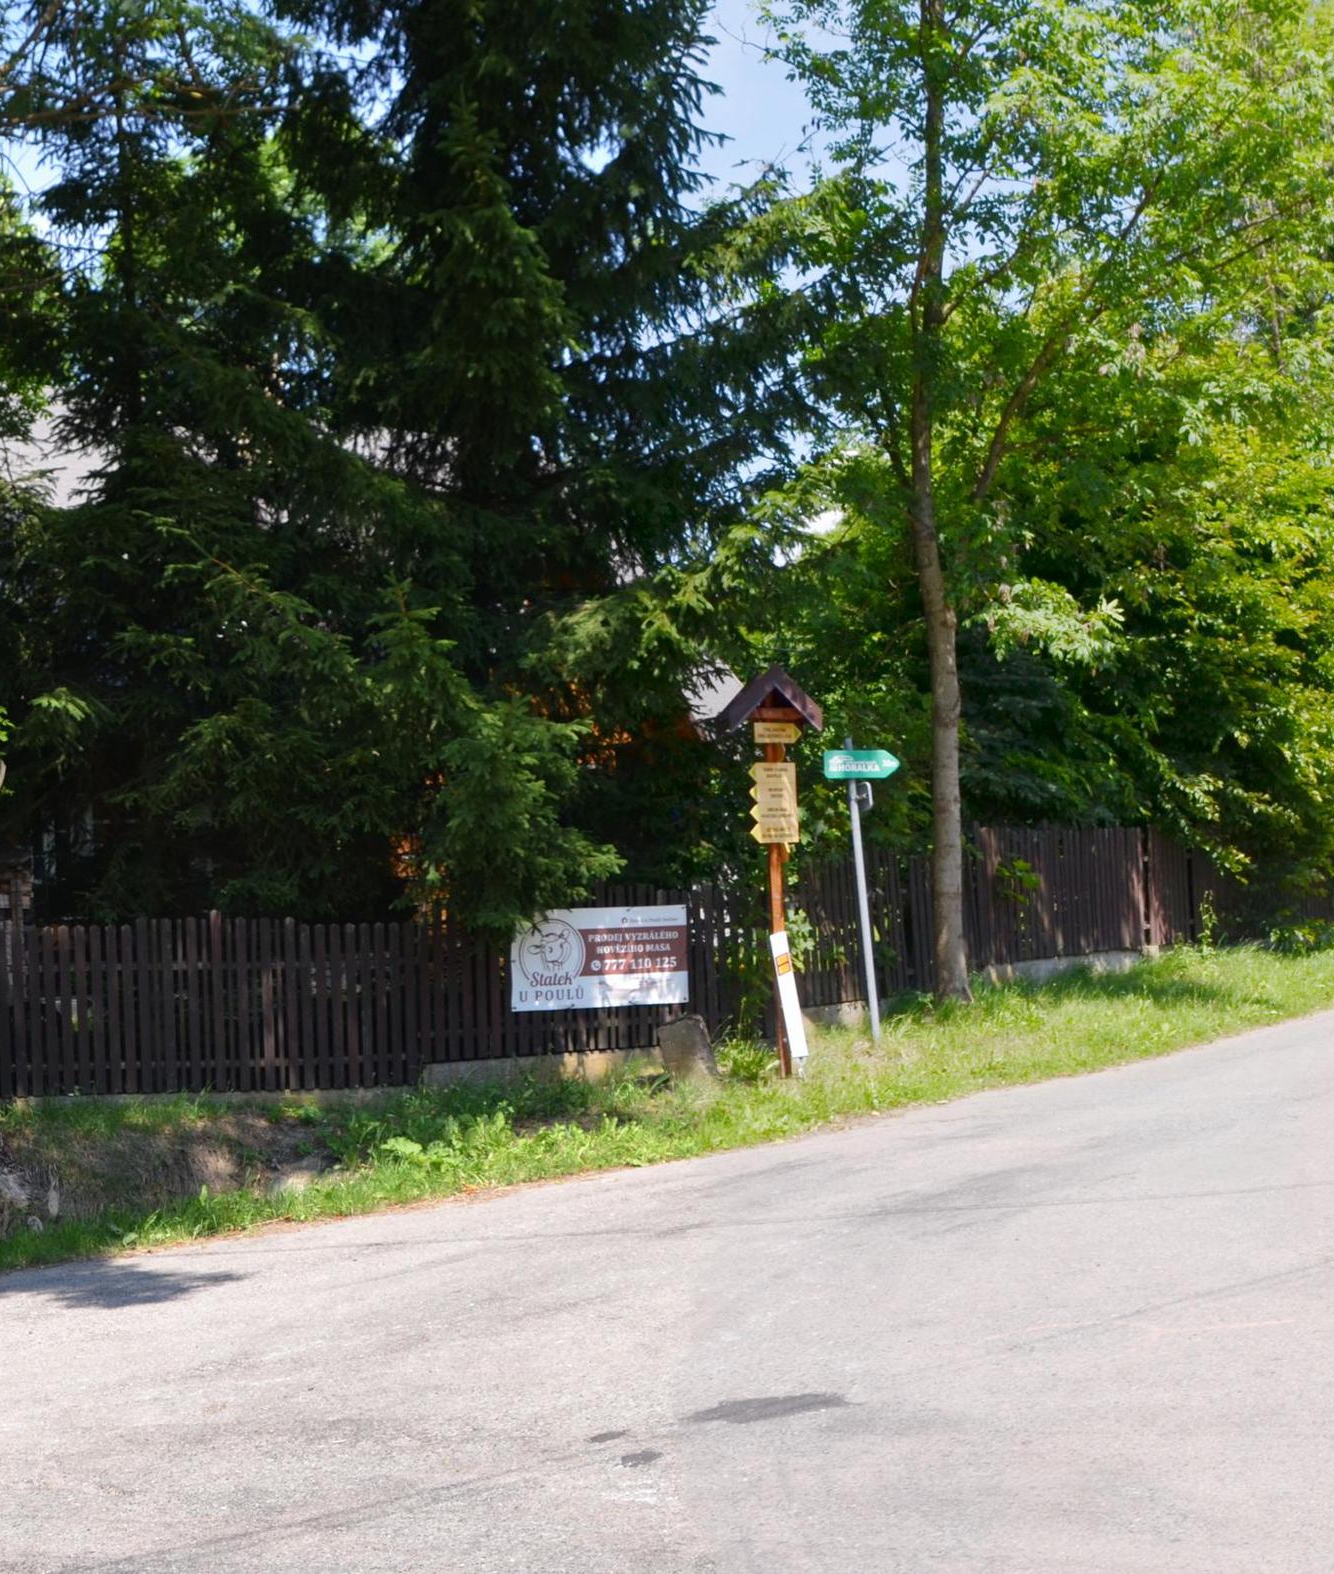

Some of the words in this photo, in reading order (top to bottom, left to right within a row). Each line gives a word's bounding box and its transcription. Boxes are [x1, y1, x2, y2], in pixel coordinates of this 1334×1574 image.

[588, 933, 622, 943] PRODEJ
[625, 930, 679, 942] VYZRÁLÉHO
[646, 943, 671, 952] MASA
[603, 958, 627, 970] 777
[630, 957, 651, 969] 110
[656, 956, 677, 968] 125
[530, 971, 573, 988] Statek
[519, 991, 528, 1002] U
